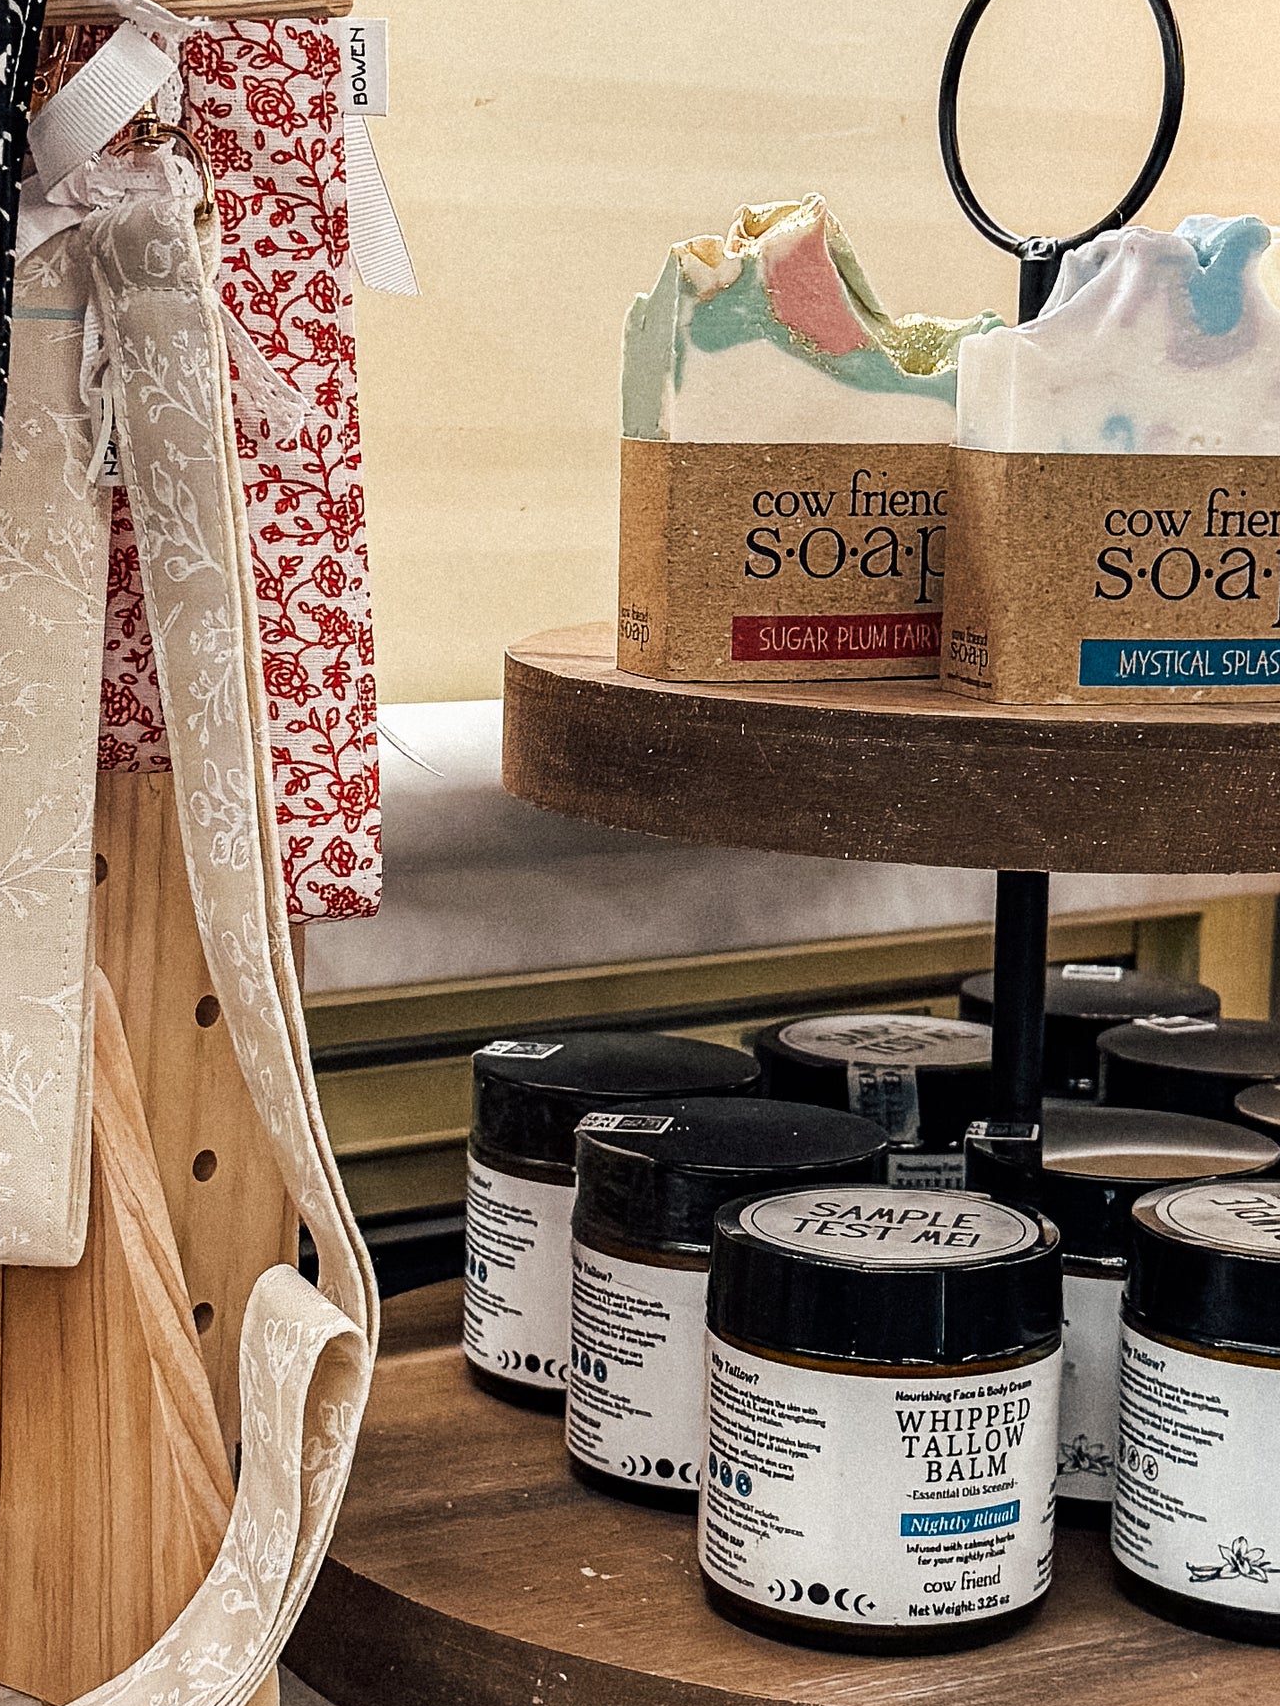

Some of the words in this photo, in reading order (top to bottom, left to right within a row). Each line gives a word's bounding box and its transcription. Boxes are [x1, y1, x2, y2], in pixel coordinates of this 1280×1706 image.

[350, 27, 367, 105] BOWEN
[752, 490, 837, 517] cow
[1104, 509, 1192, 537] cow
[760, 626, 828, 652] SUGAR
[838, 625, 887, 650] PLUM
[894, 624, 942, 650] FAIRY
[1120, 650, 1215, 677] MYSTICAL
[792, 1217, 902, 1241] TEST
[809, 1202, 981, 1230] SAMPLE
[725, 1361, 760, 1385] Tallow?
[895, 1390, 951, 1403] Nourishing
[953, 1389, 976, 1400] Face
[986, 1384, 1008, 1399] Body
[895, 1397, 1031, 1433] WHIPPED
[901, 1422, 1025, 1458] TALLOW
[925, 1451, 1008, 1483] BALM
[962, 1485, 980, 1497] Oils
[910, 1515, 970, 1534] Nightly
[973, 1505, 1014, 1528] Ritual
[923, 1578, 956, 1593] cow
[960, 1564, 1001, 1591] friend
[909, 1603, 930, 1617] Net
[932, 1601, 975, 1617] Weight:
[977, 1596, 998, 1610] 3.25
